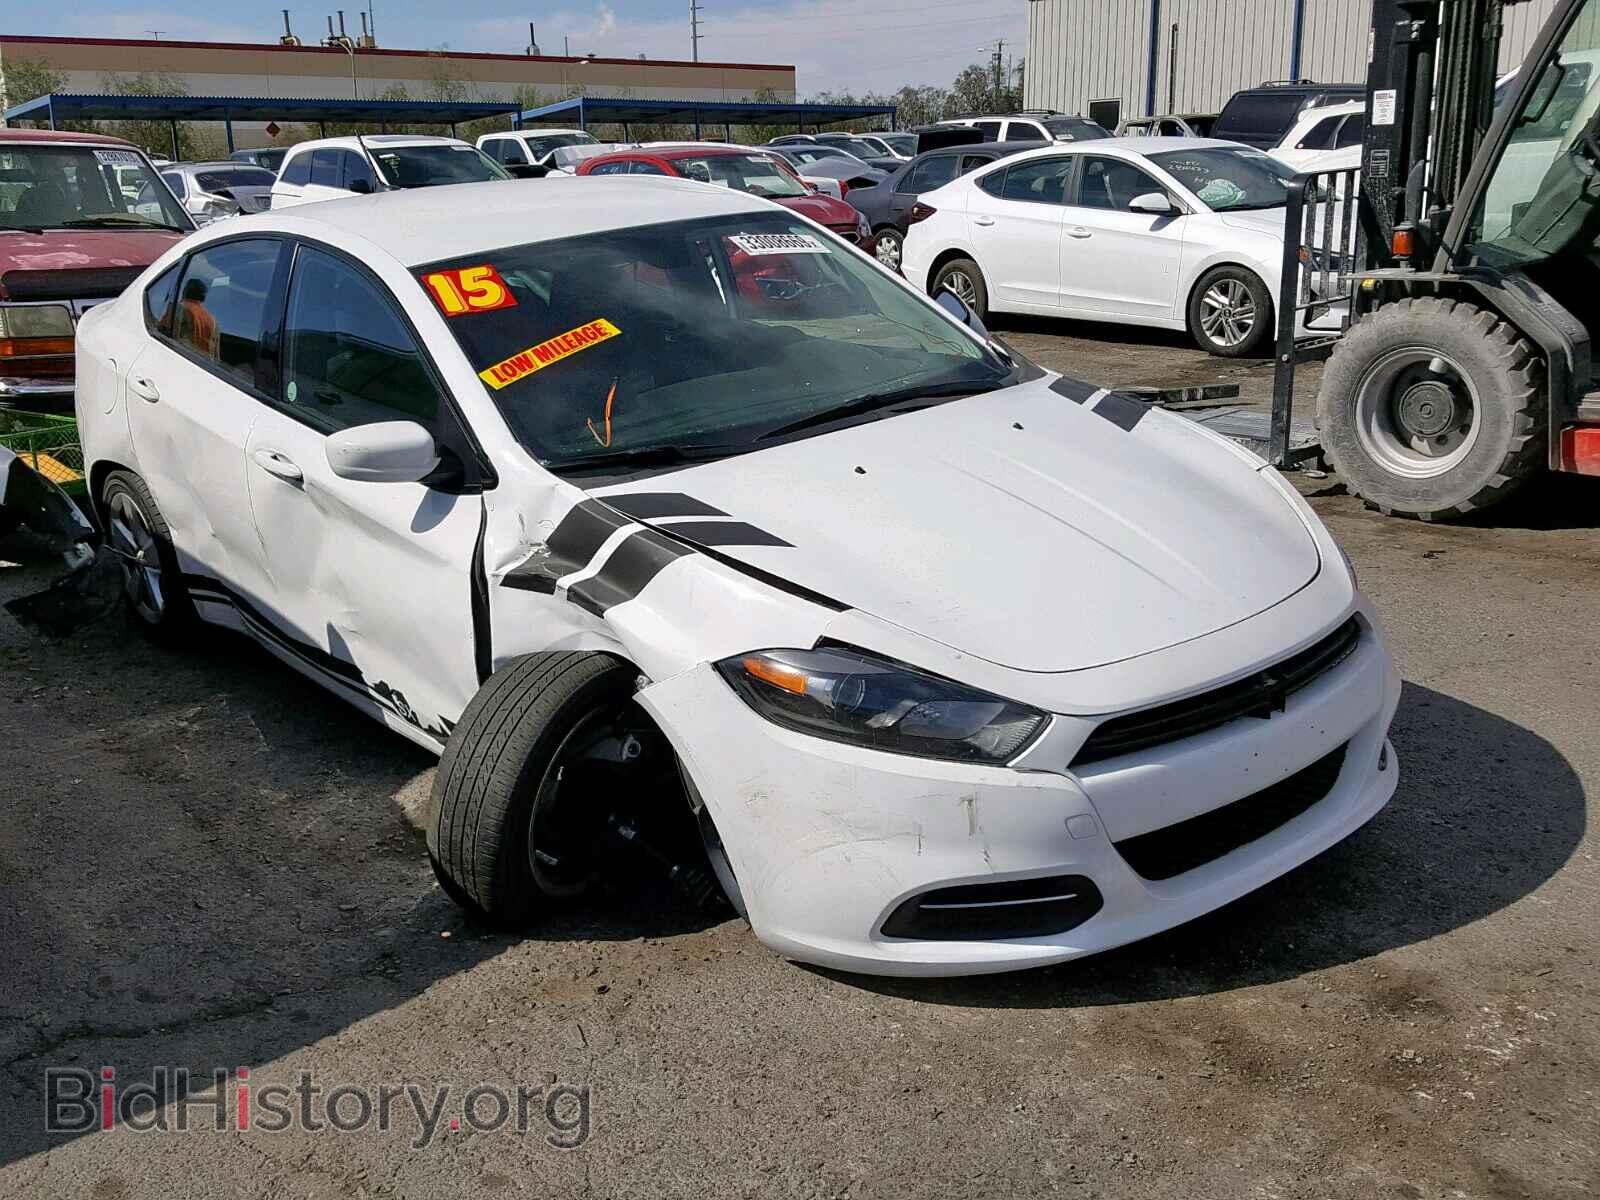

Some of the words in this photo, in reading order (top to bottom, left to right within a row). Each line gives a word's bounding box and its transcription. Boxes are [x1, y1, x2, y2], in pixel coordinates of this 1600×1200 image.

[428, 266, 506, 313] 15
[490, 352, 537, 384] LOW
[531, 322, 611, 363] MILEAGE
